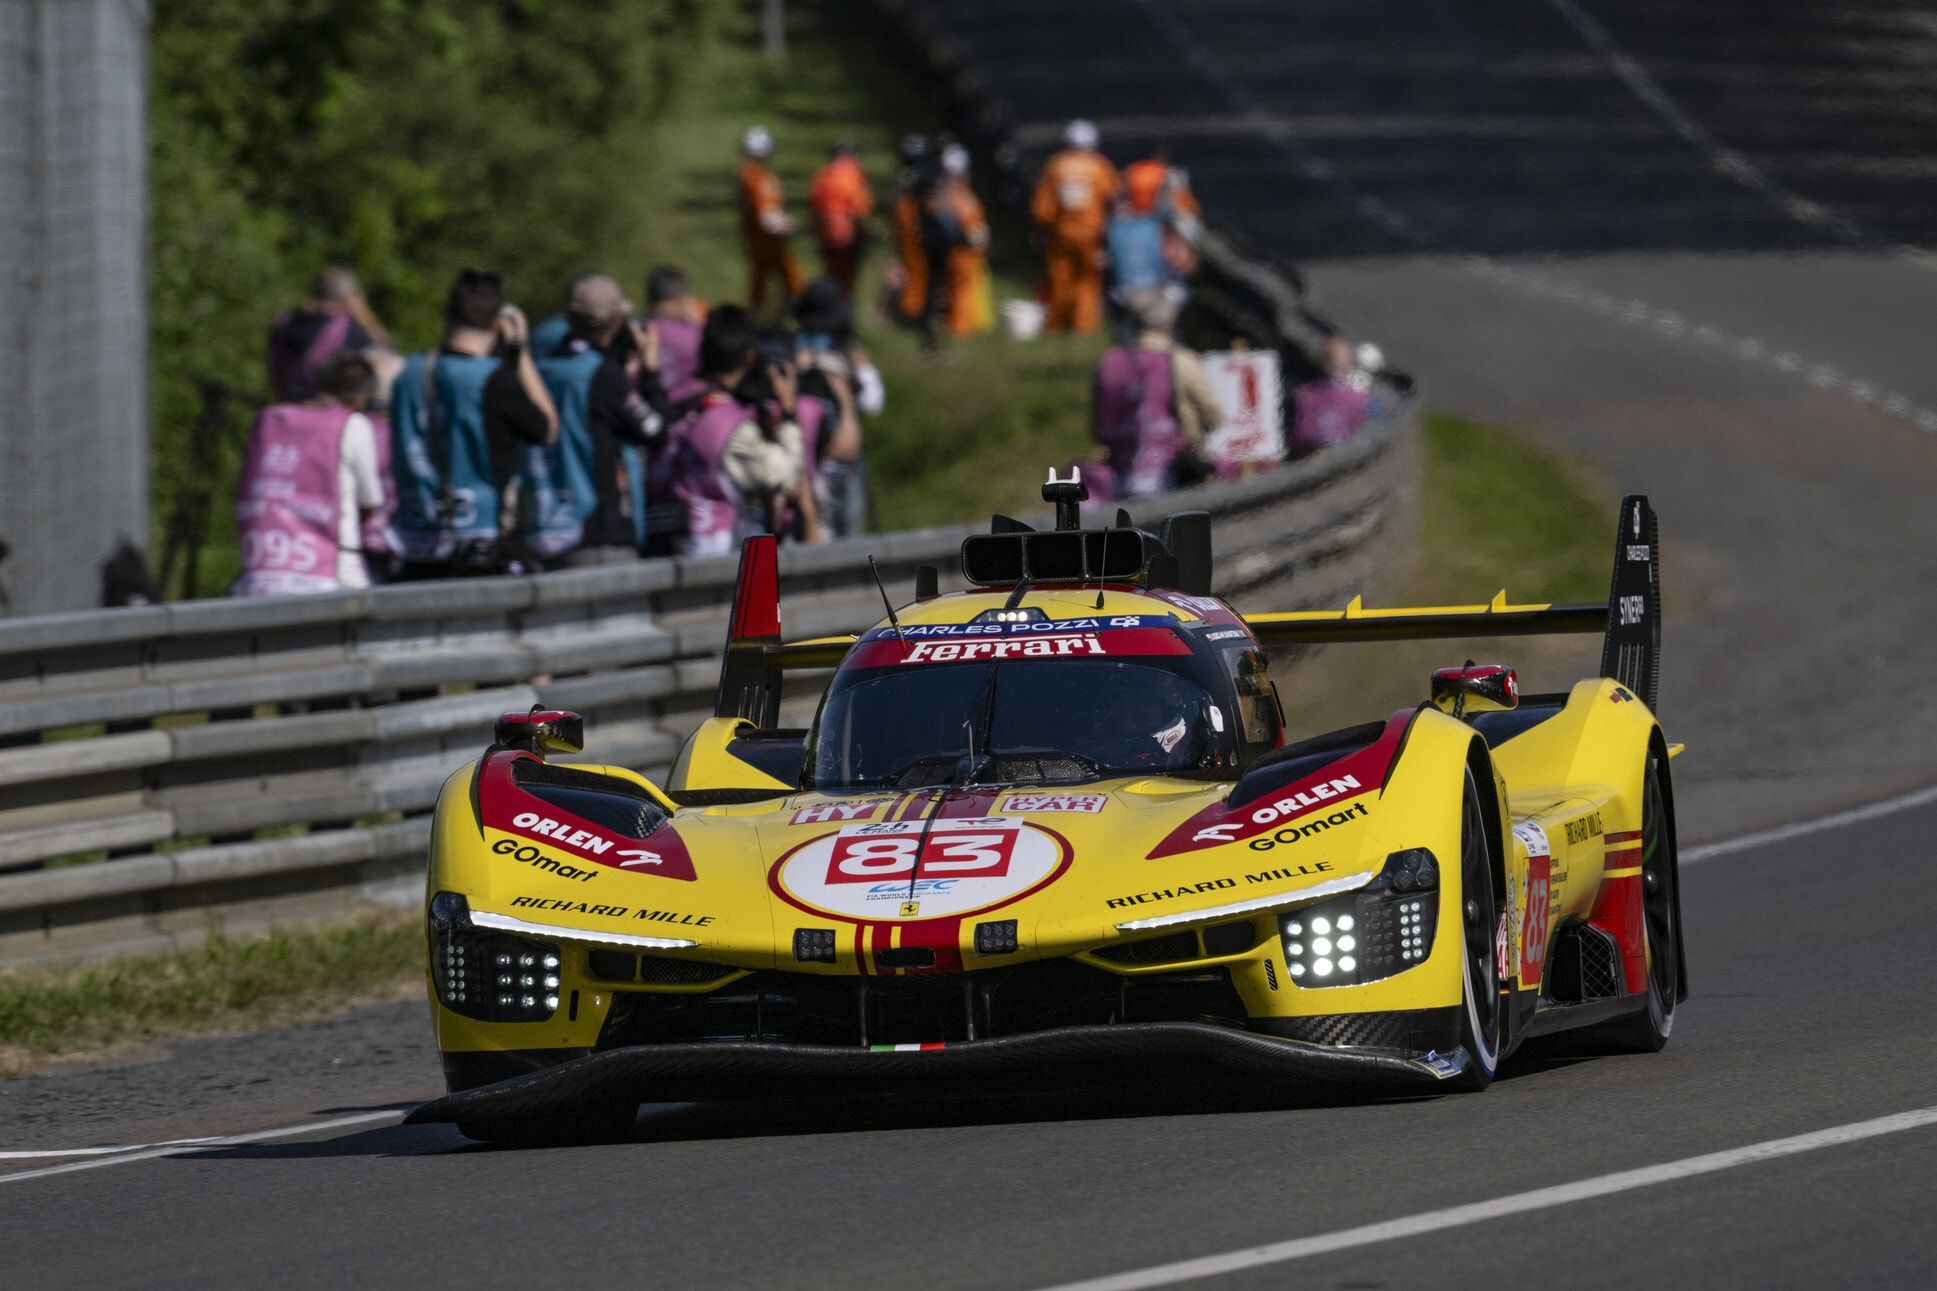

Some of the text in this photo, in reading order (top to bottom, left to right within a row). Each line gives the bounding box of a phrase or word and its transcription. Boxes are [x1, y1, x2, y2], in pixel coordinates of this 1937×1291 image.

[878, 624, 1002, 637] CHARLES
[1011, 617, 1099, 633] POZZI
[900, 633, 1106, 664] Ferrari
[795, 805, 870, 823] HY
[1009, 802, 1096, 812] CAR
[1252, 774, 1362, 824] ORLEN
[513, 812, 615, 855] ORLEN
[1249, 802, 1368, 851] GOmart
[492, 839, 599, 883] GOmart
[838, 835, 1004, 875] 83
[868, 880, 960, 892] WEC
[1106, 861, 1334, 909] RICHARD MILLE
[510, 896, 715, 926] RICHARD MILLE
[1526, 879, 1547, 964] 83
